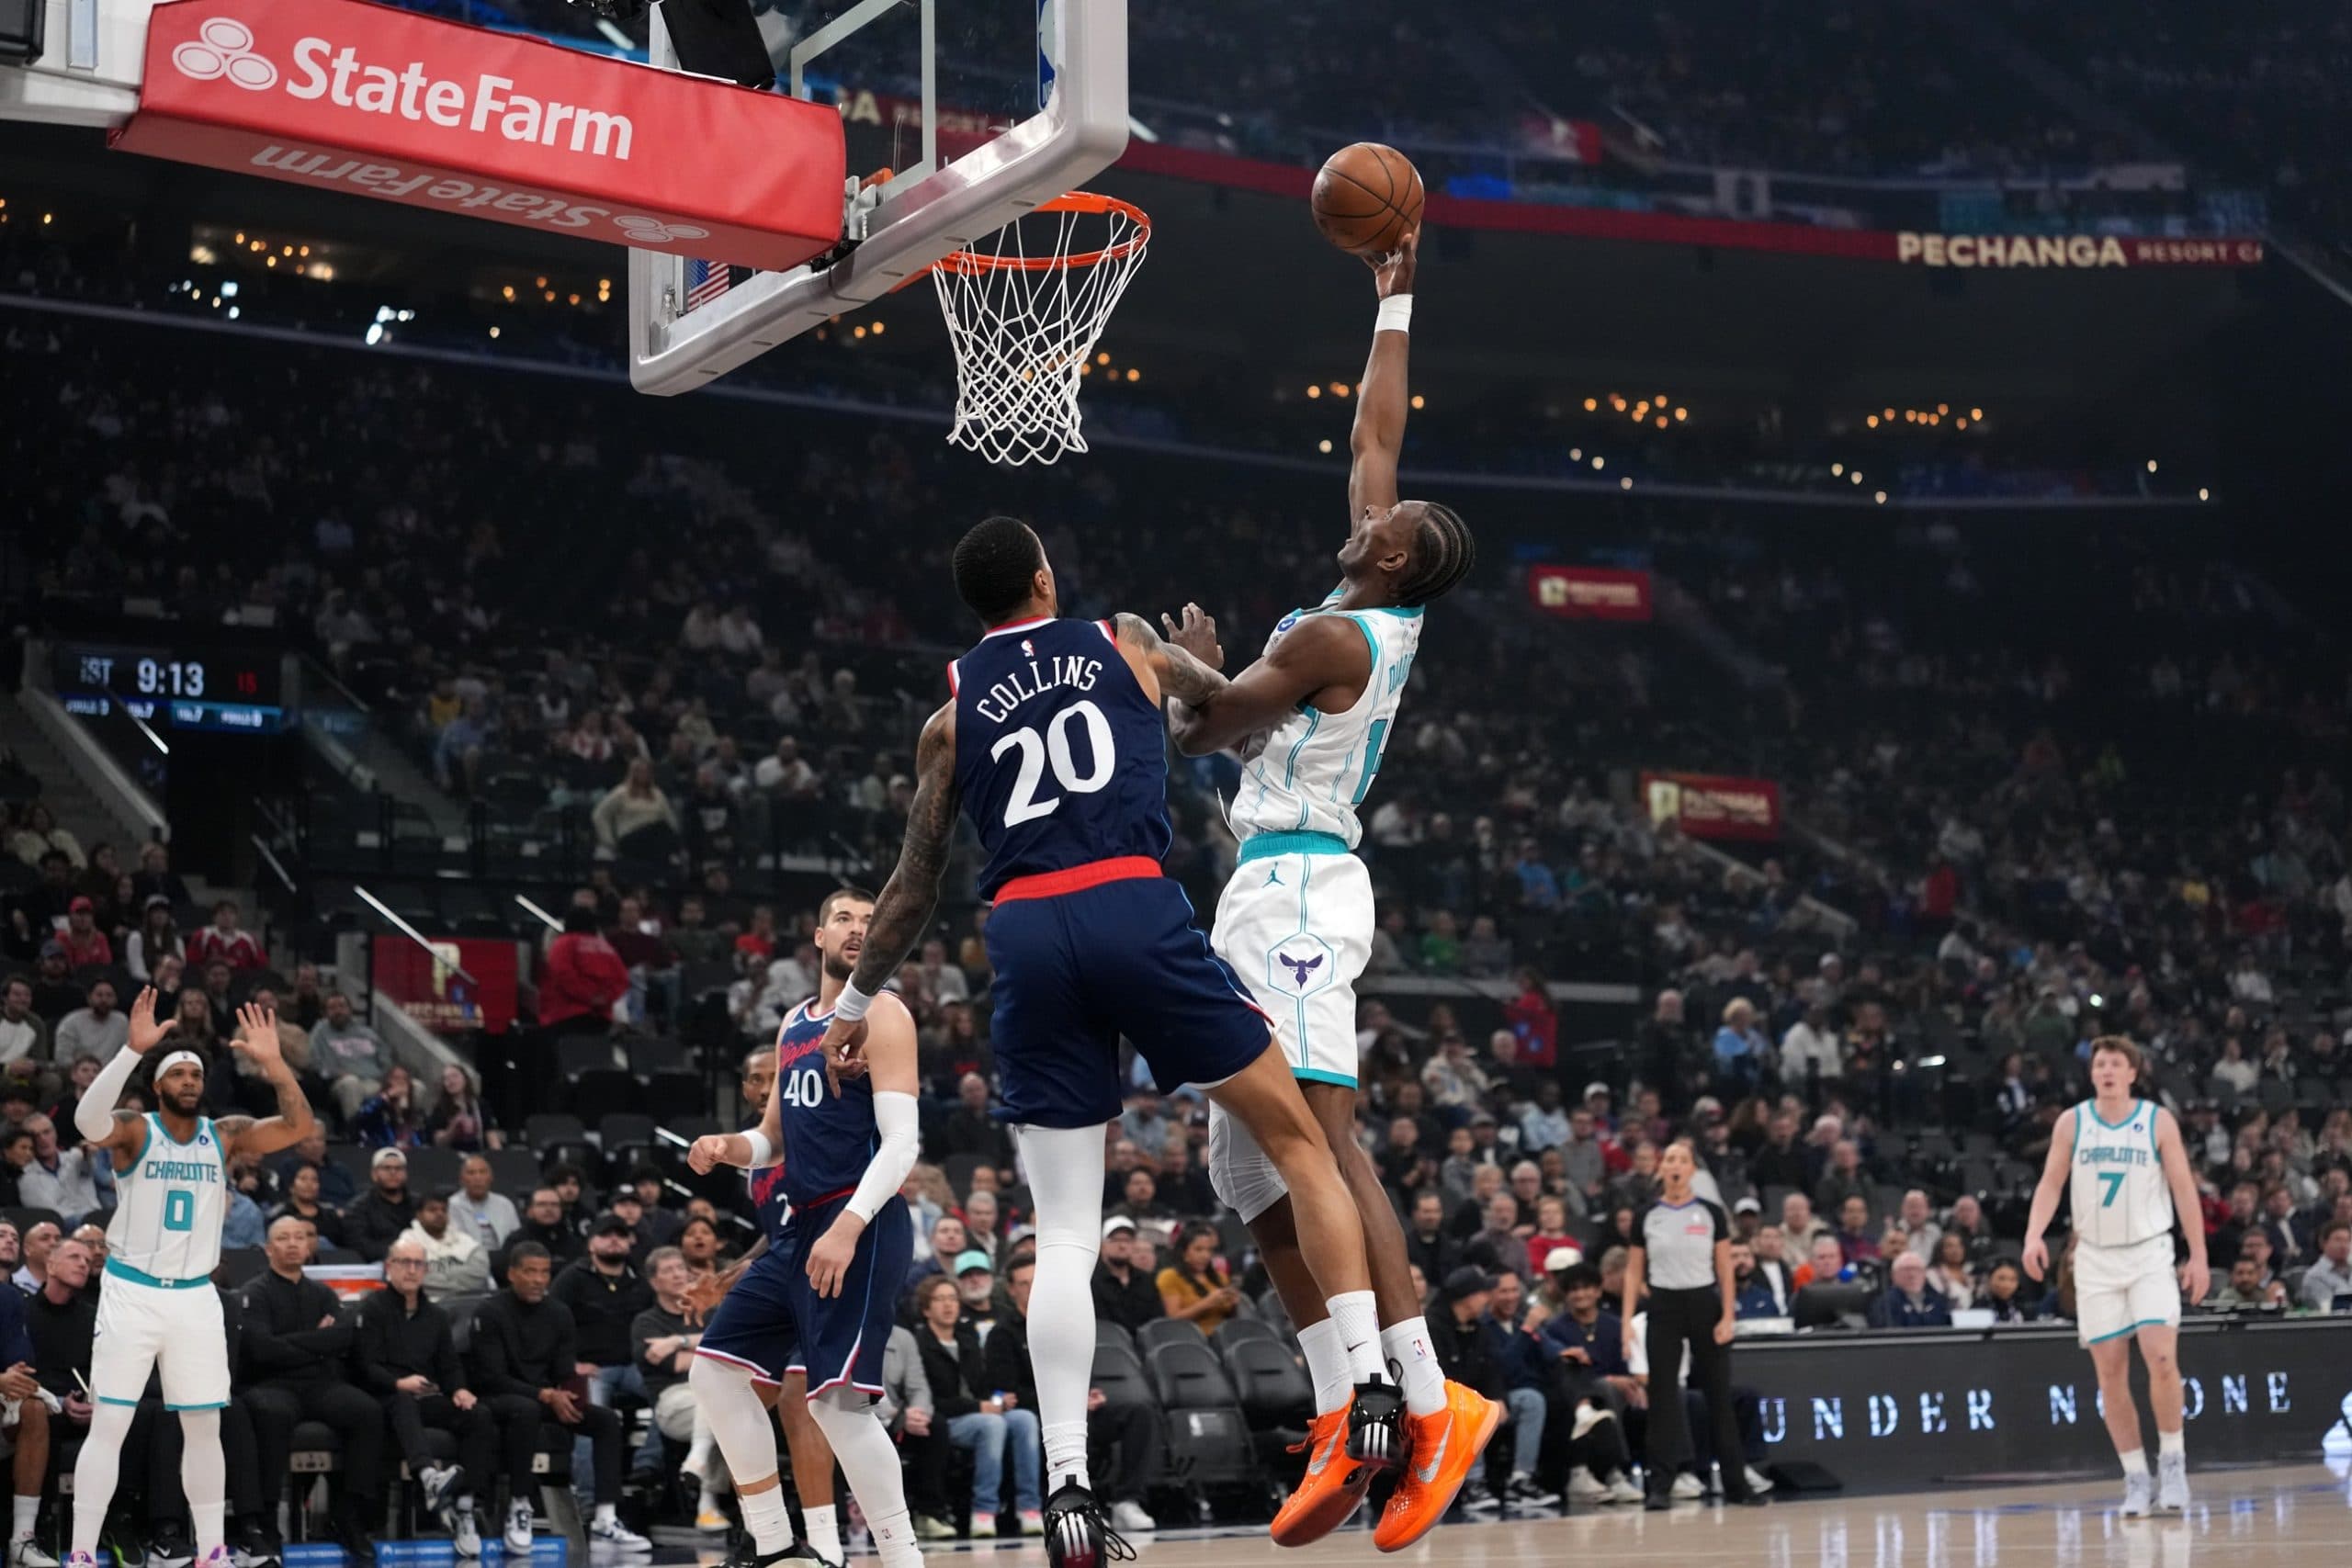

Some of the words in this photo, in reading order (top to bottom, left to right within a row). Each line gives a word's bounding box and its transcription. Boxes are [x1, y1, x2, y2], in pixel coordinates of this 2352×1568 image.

[1896, 231, 2128, 267] PECHANGA
[2136, 241, 2227, 264] RESORT
[137, 658, 204, 696] 9:13
[977, 655, 1102, 723] COLLINS
[990, 700, 1116, 829] 20
[783, 1069, 823, 1108] 40
[145, 1160, 218, 1183] CHARLOTTE
[2079, 1146, 2147, 1168] CHARLOTTE
[2098, 1171, 2126, 1208] 7
[164, 1190, 195, 1232] 0
[1758, 1389, 1996, 1443] UNDER
